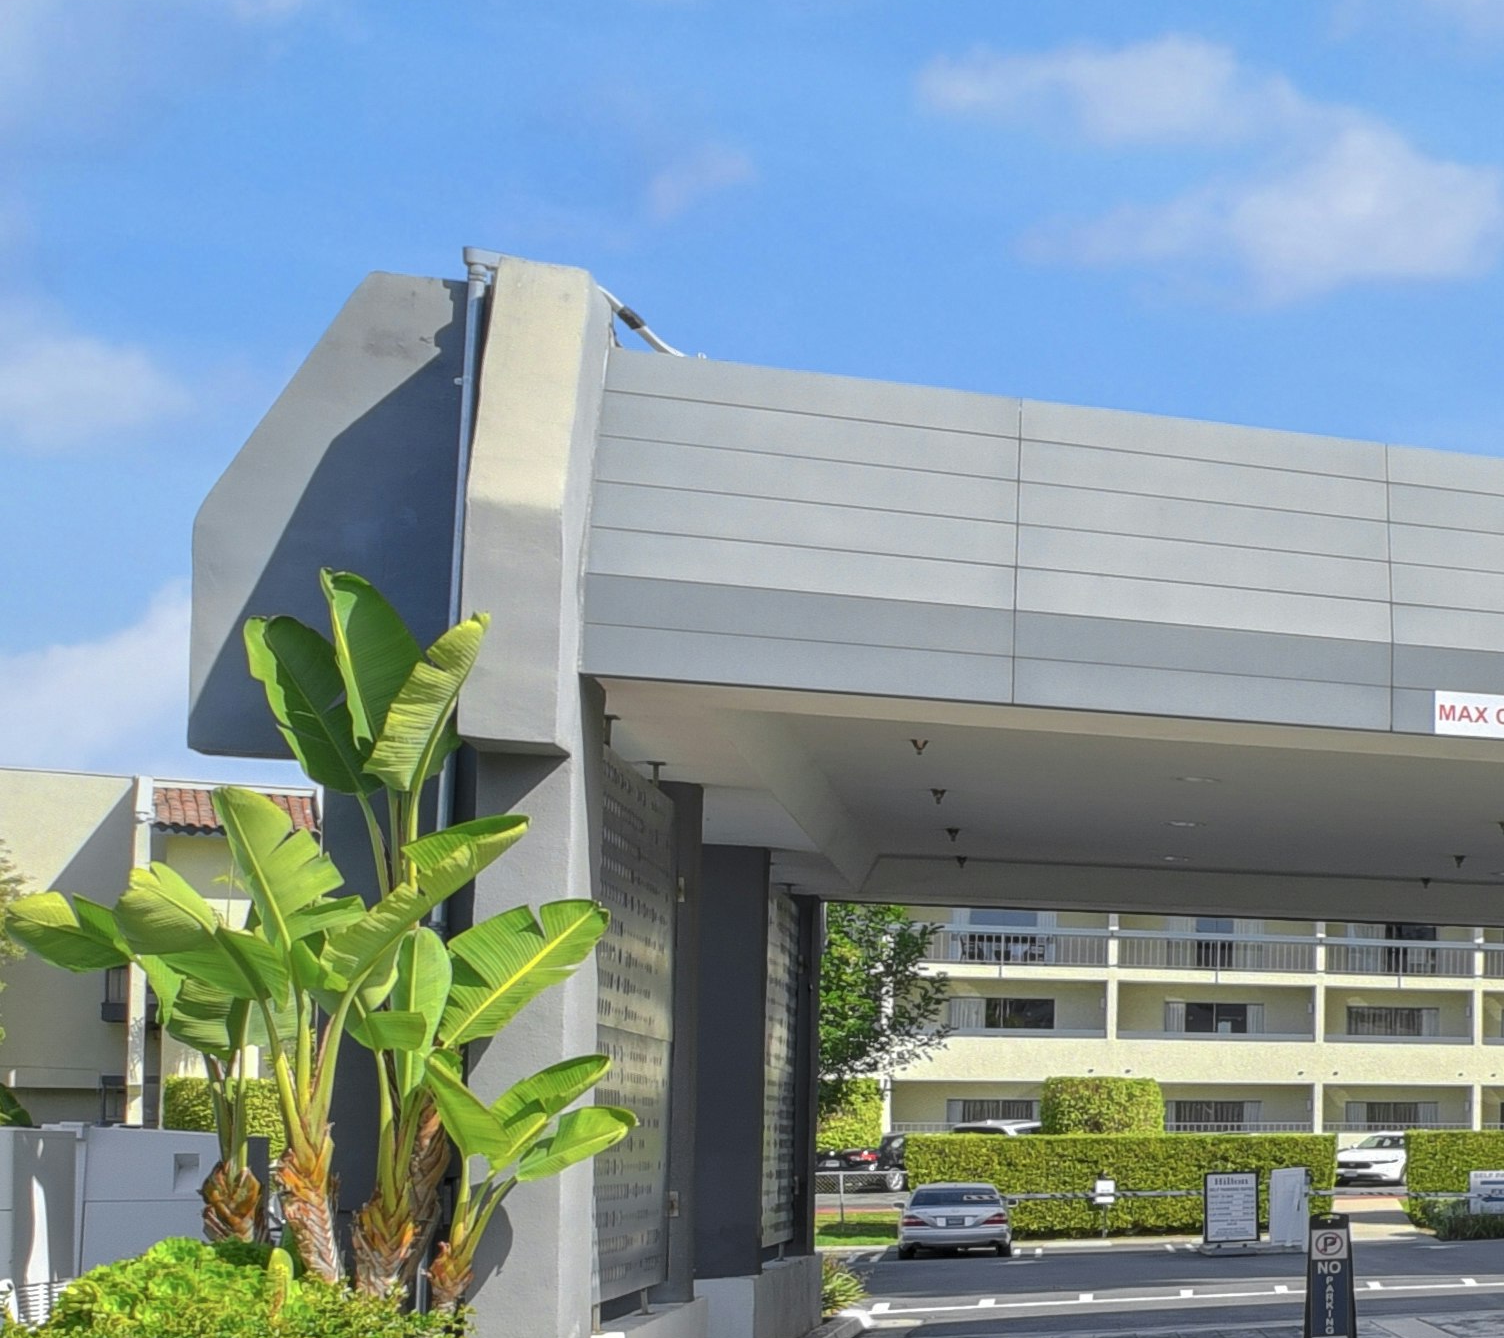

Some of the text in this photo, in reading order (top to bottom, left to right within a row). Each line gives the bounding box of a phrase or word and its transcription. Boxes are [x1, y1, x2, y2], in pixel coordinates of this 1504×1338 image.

[1438, 704, 1489, 724] MAX
[1214, 1177, 1249, 1186] Hilton
[1317, 1261, 1342, 1274] NO
[1325, 1275, 1335, 1334] PARKING
